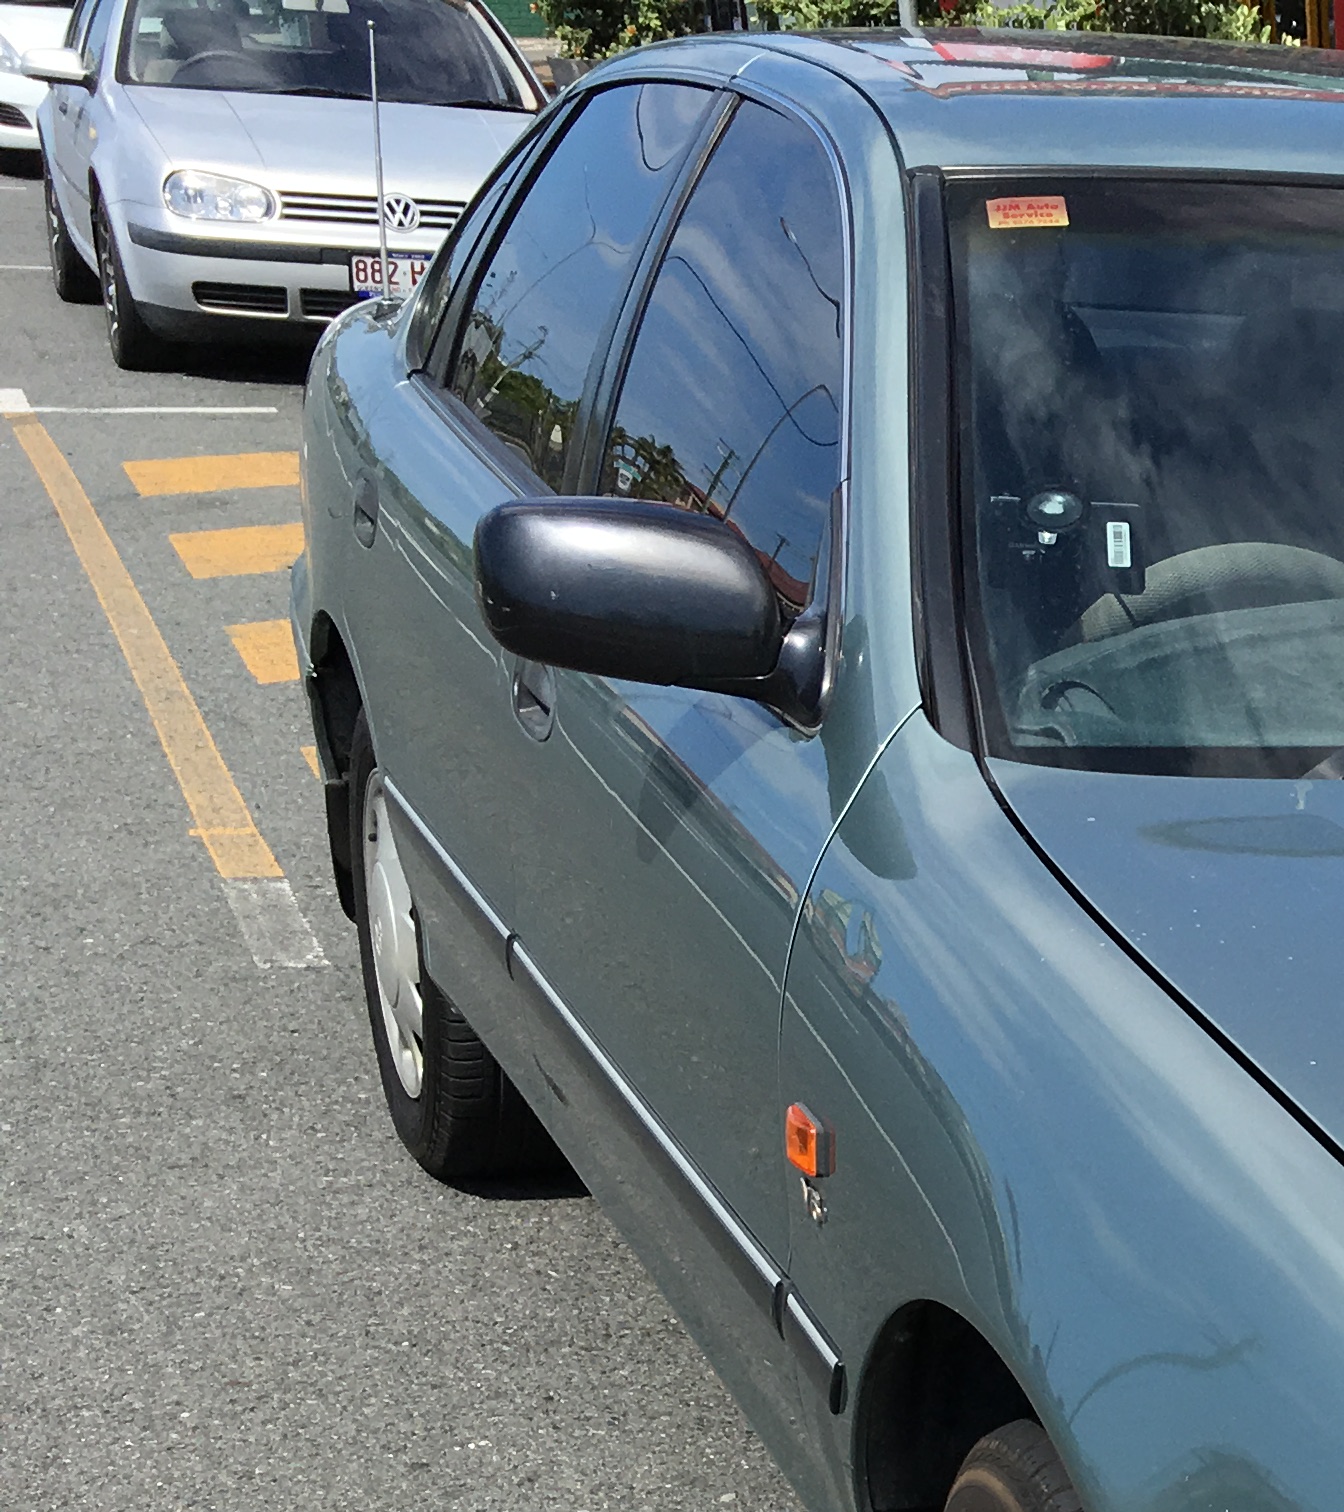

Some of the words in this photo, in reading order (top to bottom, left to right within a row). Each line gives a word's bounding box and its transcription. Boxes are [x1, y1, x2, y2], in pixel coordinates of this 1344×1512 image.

[1026, 202, 1059, 211] Auto
[1002, 210, 1054, 220] Service
[355, 259, 400, 286] 882
